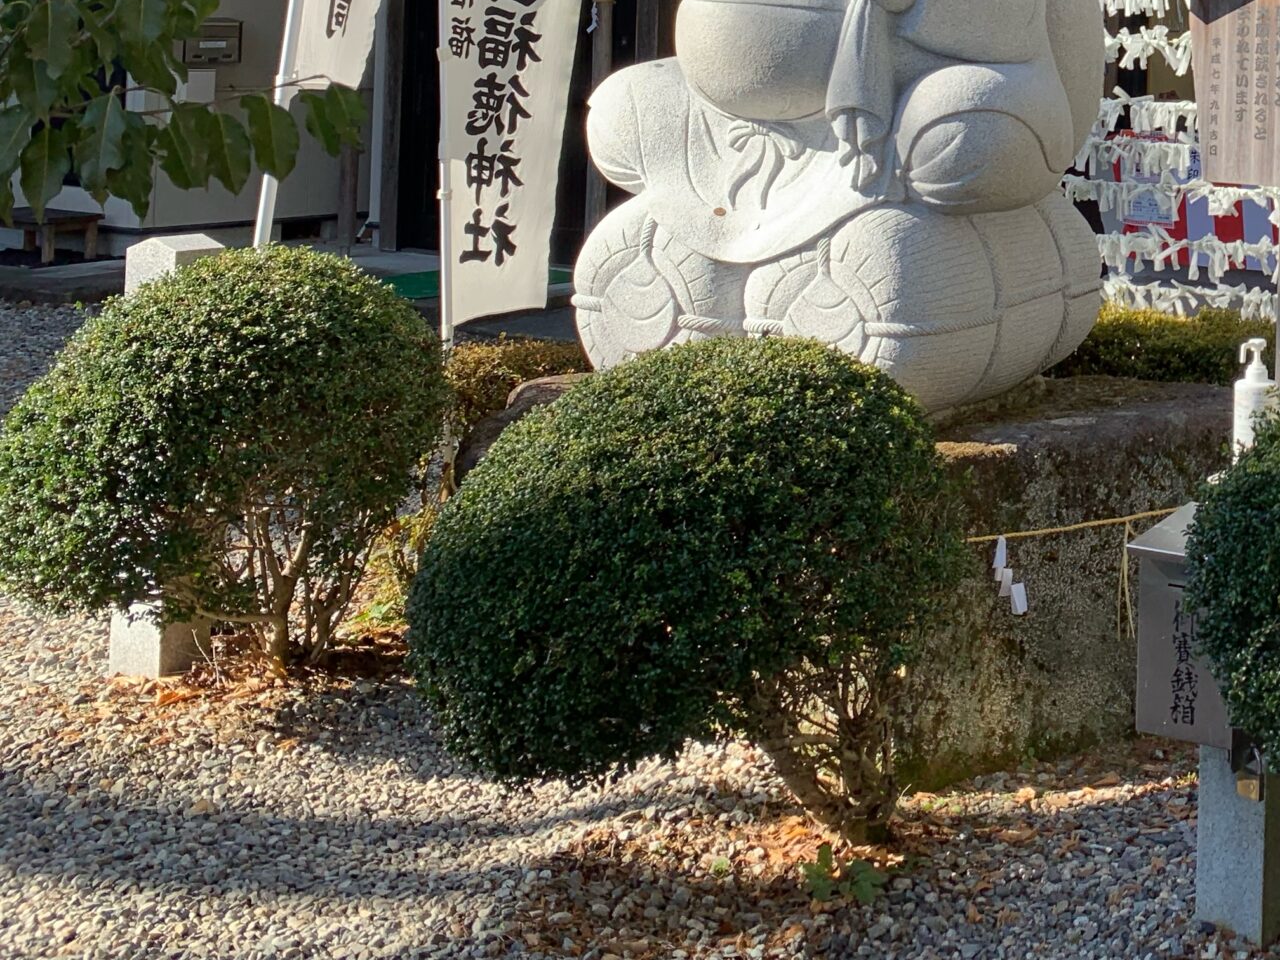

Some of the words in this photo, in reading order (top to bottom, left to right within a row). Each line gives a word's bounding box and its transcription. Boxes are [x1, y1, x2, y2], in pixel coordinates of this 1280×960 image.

[1209, 37, 1221, 157] 平成七年九月吉日
